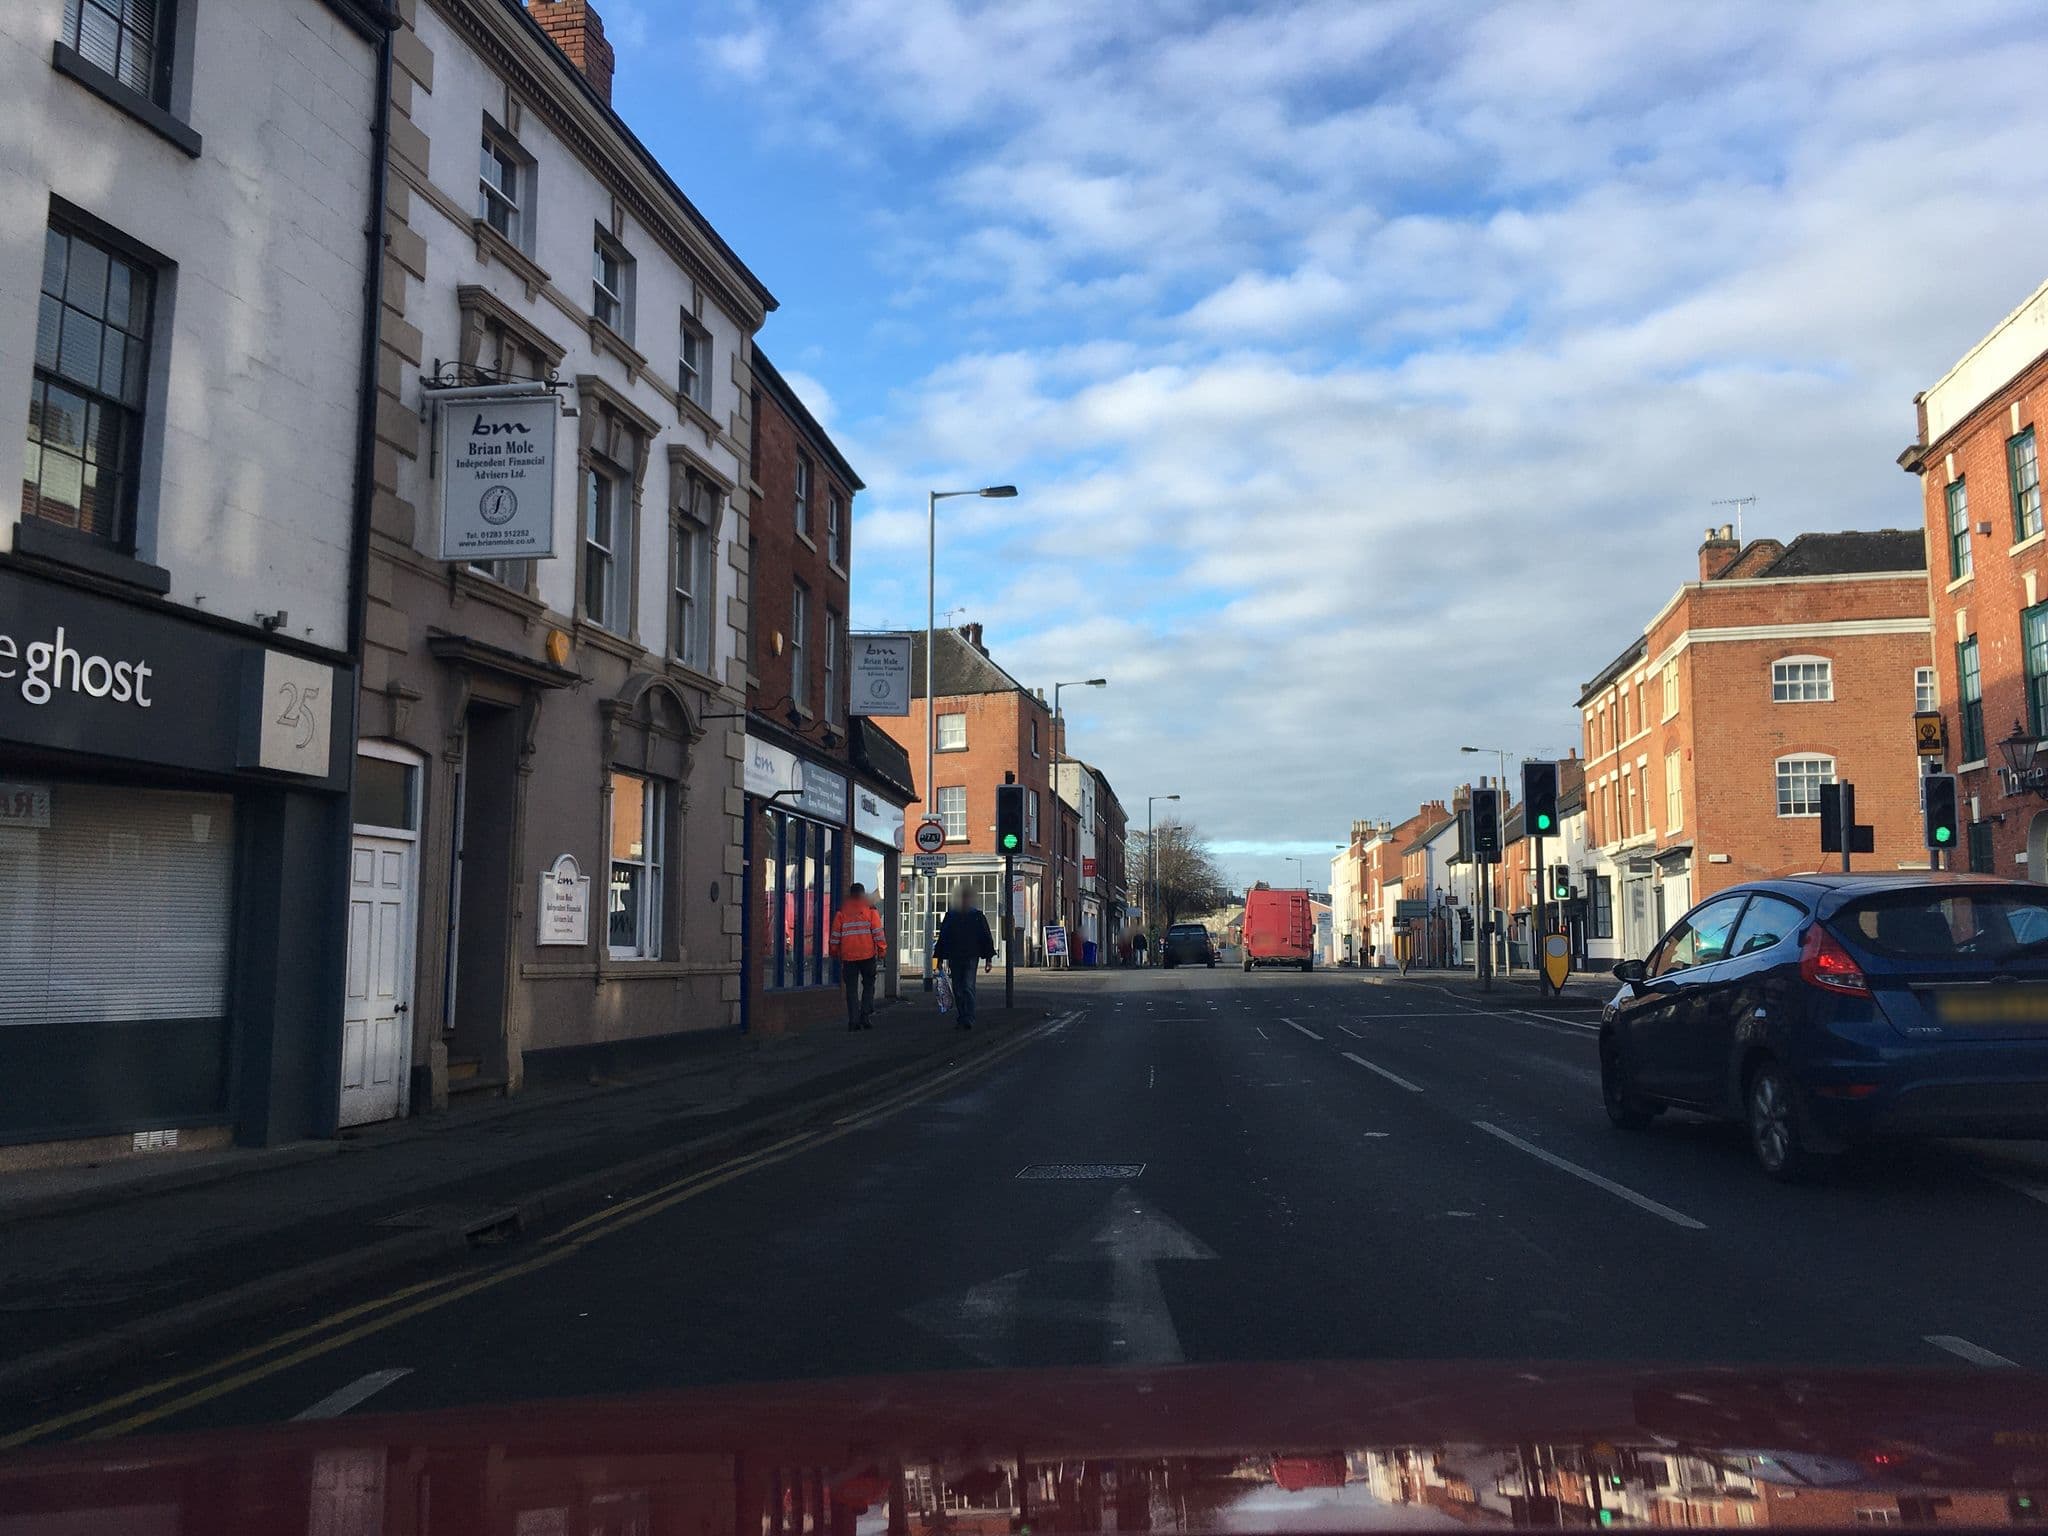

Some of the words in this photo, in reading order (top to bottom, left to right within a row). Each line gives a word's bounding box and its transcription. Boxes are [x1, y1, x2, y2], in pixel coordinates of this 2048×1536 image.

[472, 414, 531, 435] bm
[469, 442, 502, 456] Brian
[506, 440, 534, 454] Mole
[456, 459, 506, 469] Independent
[509, 456, 545, 466] Financial
[475, 470, 508, 480] Advisers
[511, 469, 526, 478] Ltd.
[481, 531, 502, 539] 01283
[458, 538, 536, 548] www.brianmole.co.uk
[22, 626, 153, 708] ghost
[276, 681, 319, 749] 25
